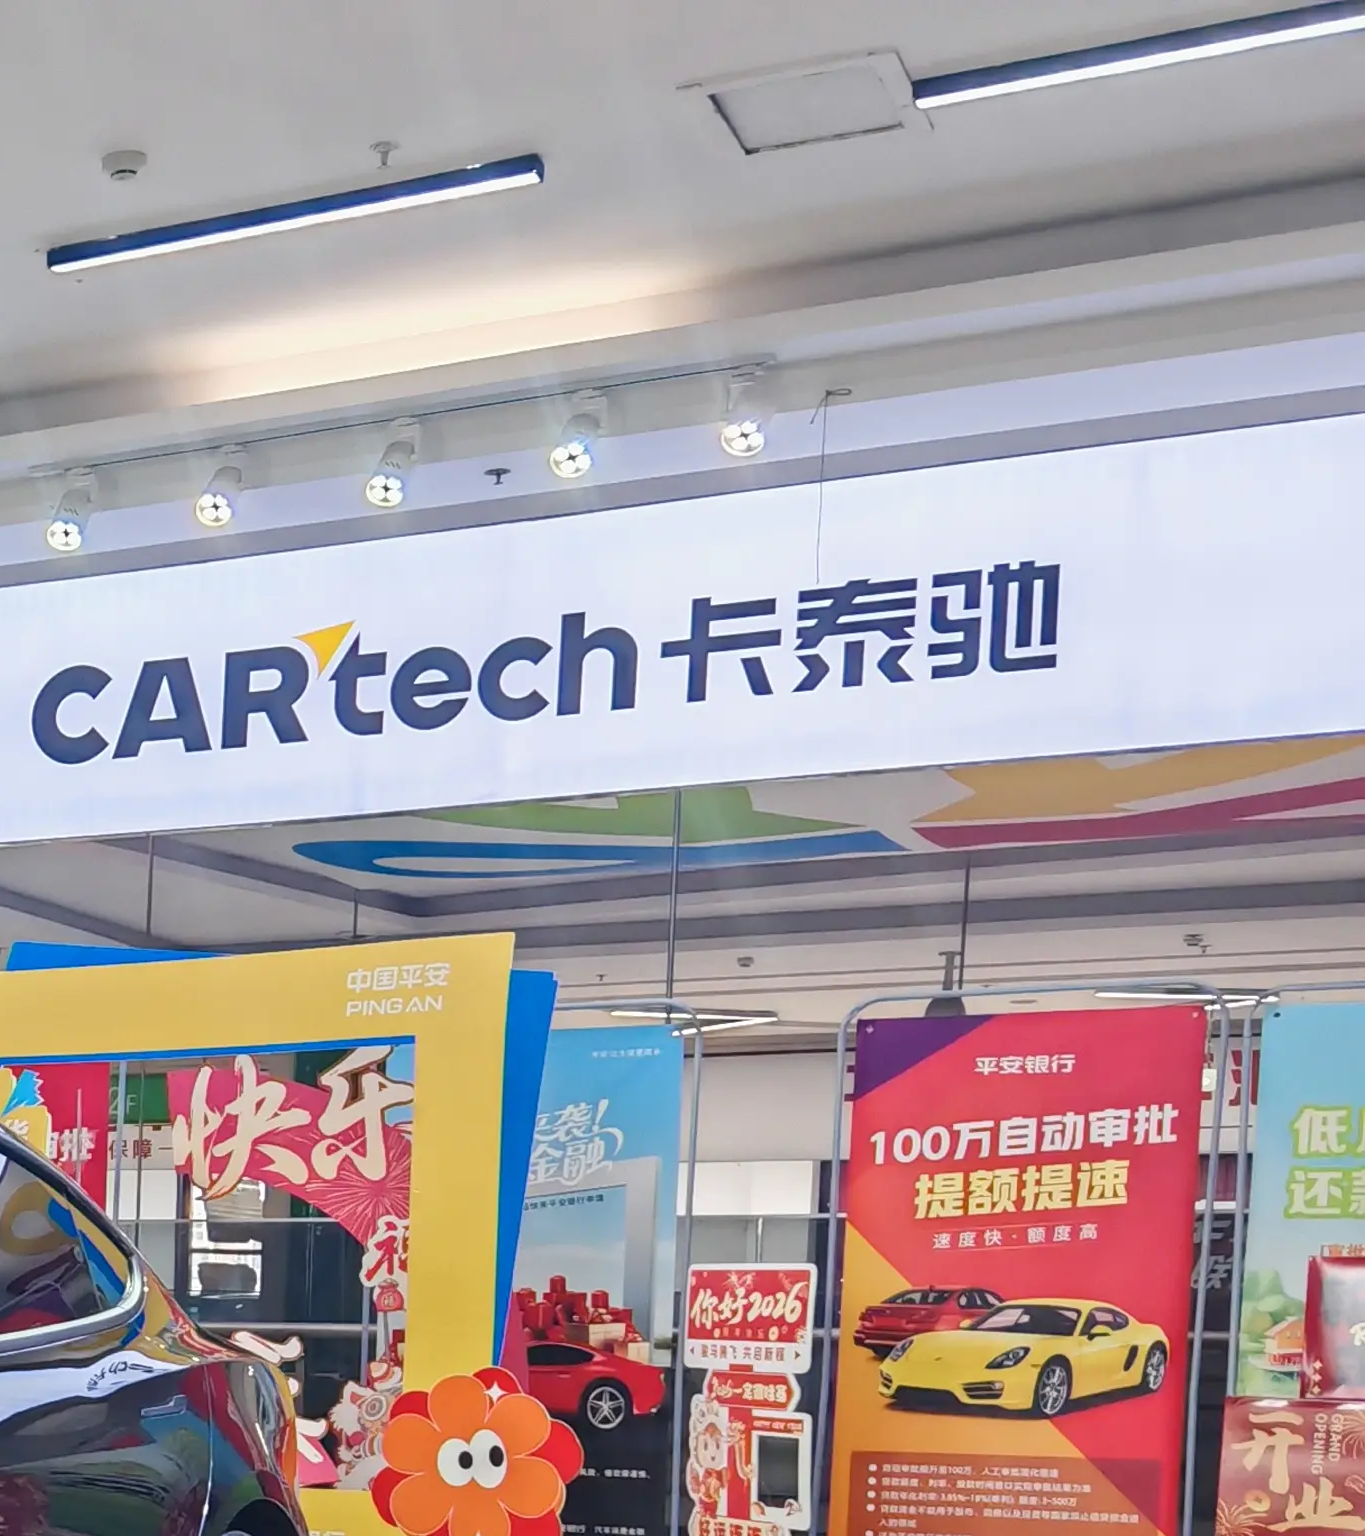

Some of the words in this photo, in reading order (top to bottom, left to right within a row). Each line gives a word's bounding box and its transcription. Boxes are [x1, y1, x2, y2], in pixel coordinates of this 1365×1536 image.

[31, 611, 636, 764] CARtech
[660, 562, 1060, 703] 卡泰驰
[346, 962, 451, 994] 中国平安
[974, 1053, 1076, 1076] 平安银行
[171, 1046, 415, 1201] 快乐
[870, 1103, 1178, 1165] 100万自动审批
[914, 1159, 1131, 1220] 提额提速
[691, 1281, 809, 1330] 你好2026
[1311, 1414, 1328, 1475] OPENING
[1328, 1414, 1344, 1463] GRAND
